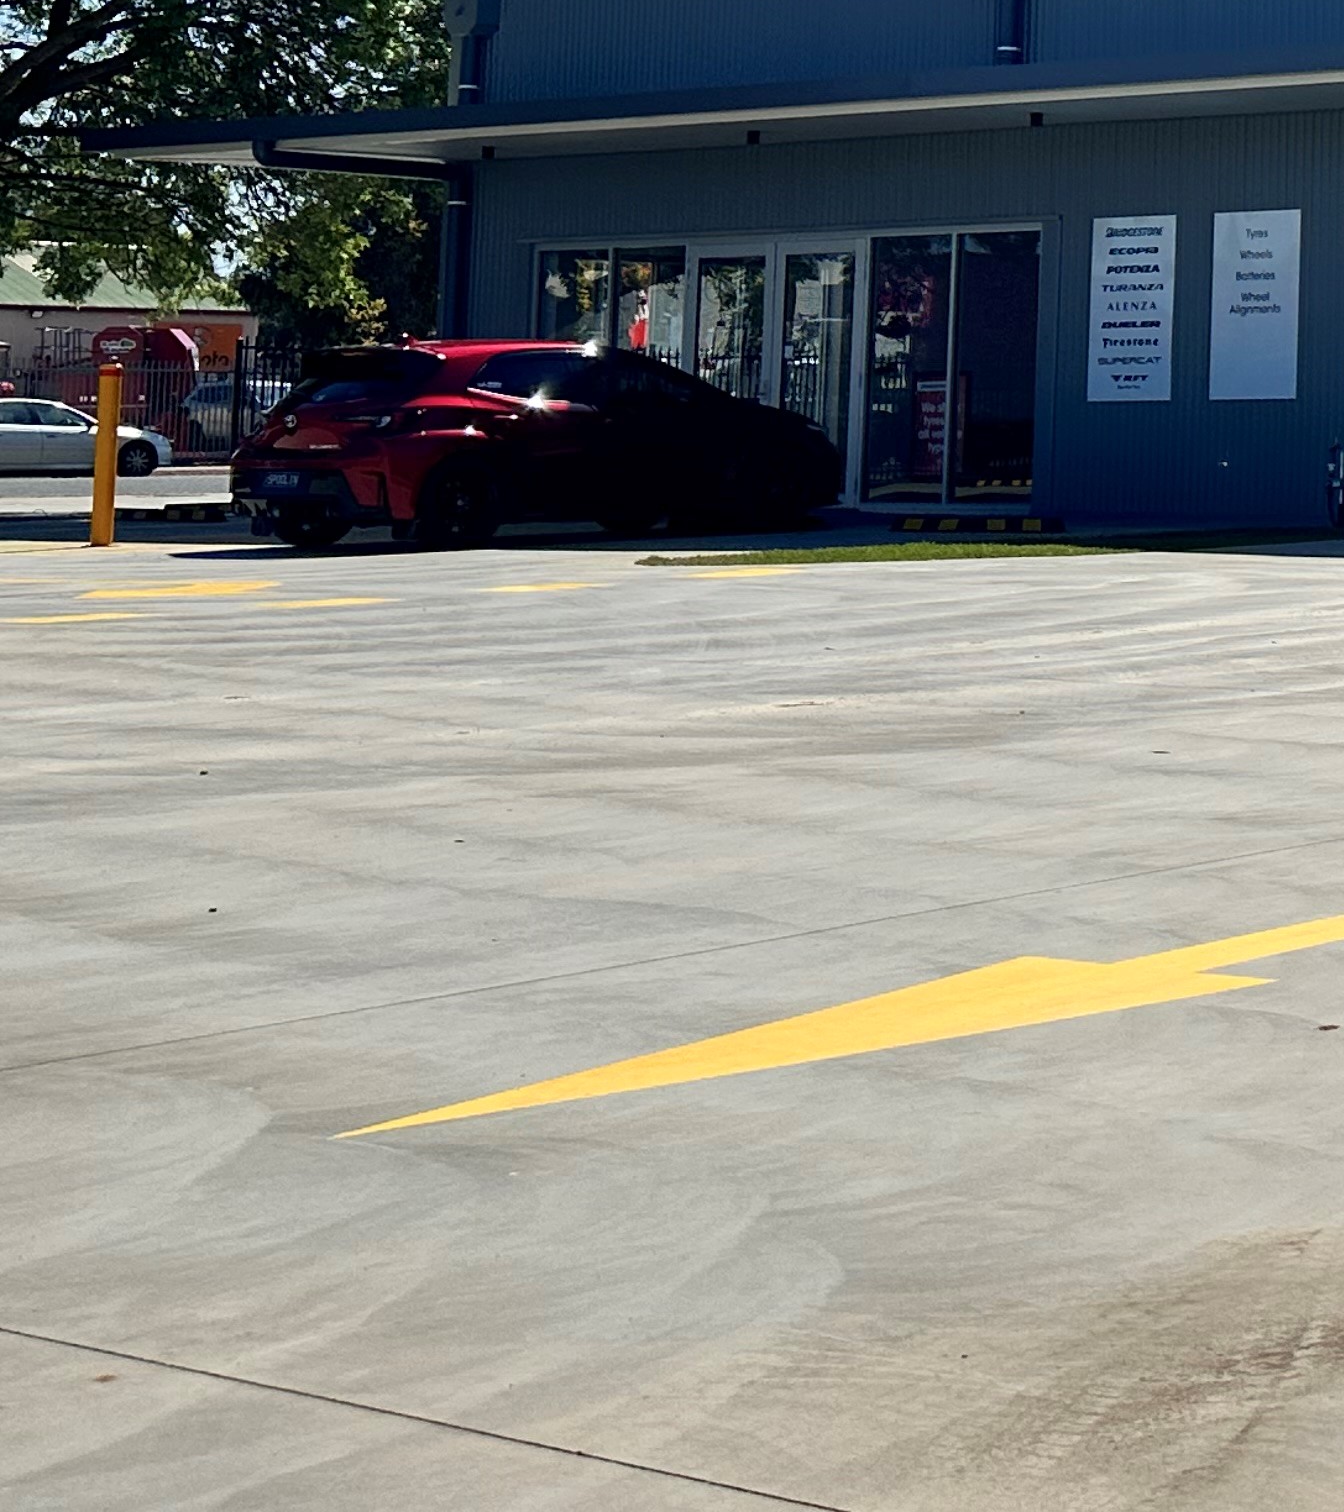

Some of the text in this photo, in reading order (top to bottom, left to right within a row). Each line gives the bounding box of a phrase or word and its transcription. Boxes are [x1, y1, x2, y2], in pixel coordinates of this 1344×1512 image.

[1246, 229, 1268, 239] Tyres
[1240, 249, 1273, 259] Wheels
[1106, 264, 1160, 274] POTENZA
[1235, 271, 1275, 281] Batteries
[1102, 284, 1164, 292] TURANZA
[1240, 292, 1270, 302] Wheel
[1107, 301, 1157, 311] ALENZA
[1229, 304, 1281, 316] Alignments
[1101, 320, 1161, 329] DUELER
[1102, 338, 1159, 349] Firestone
[1098, 357, 1162, 365] SUPERCAT
